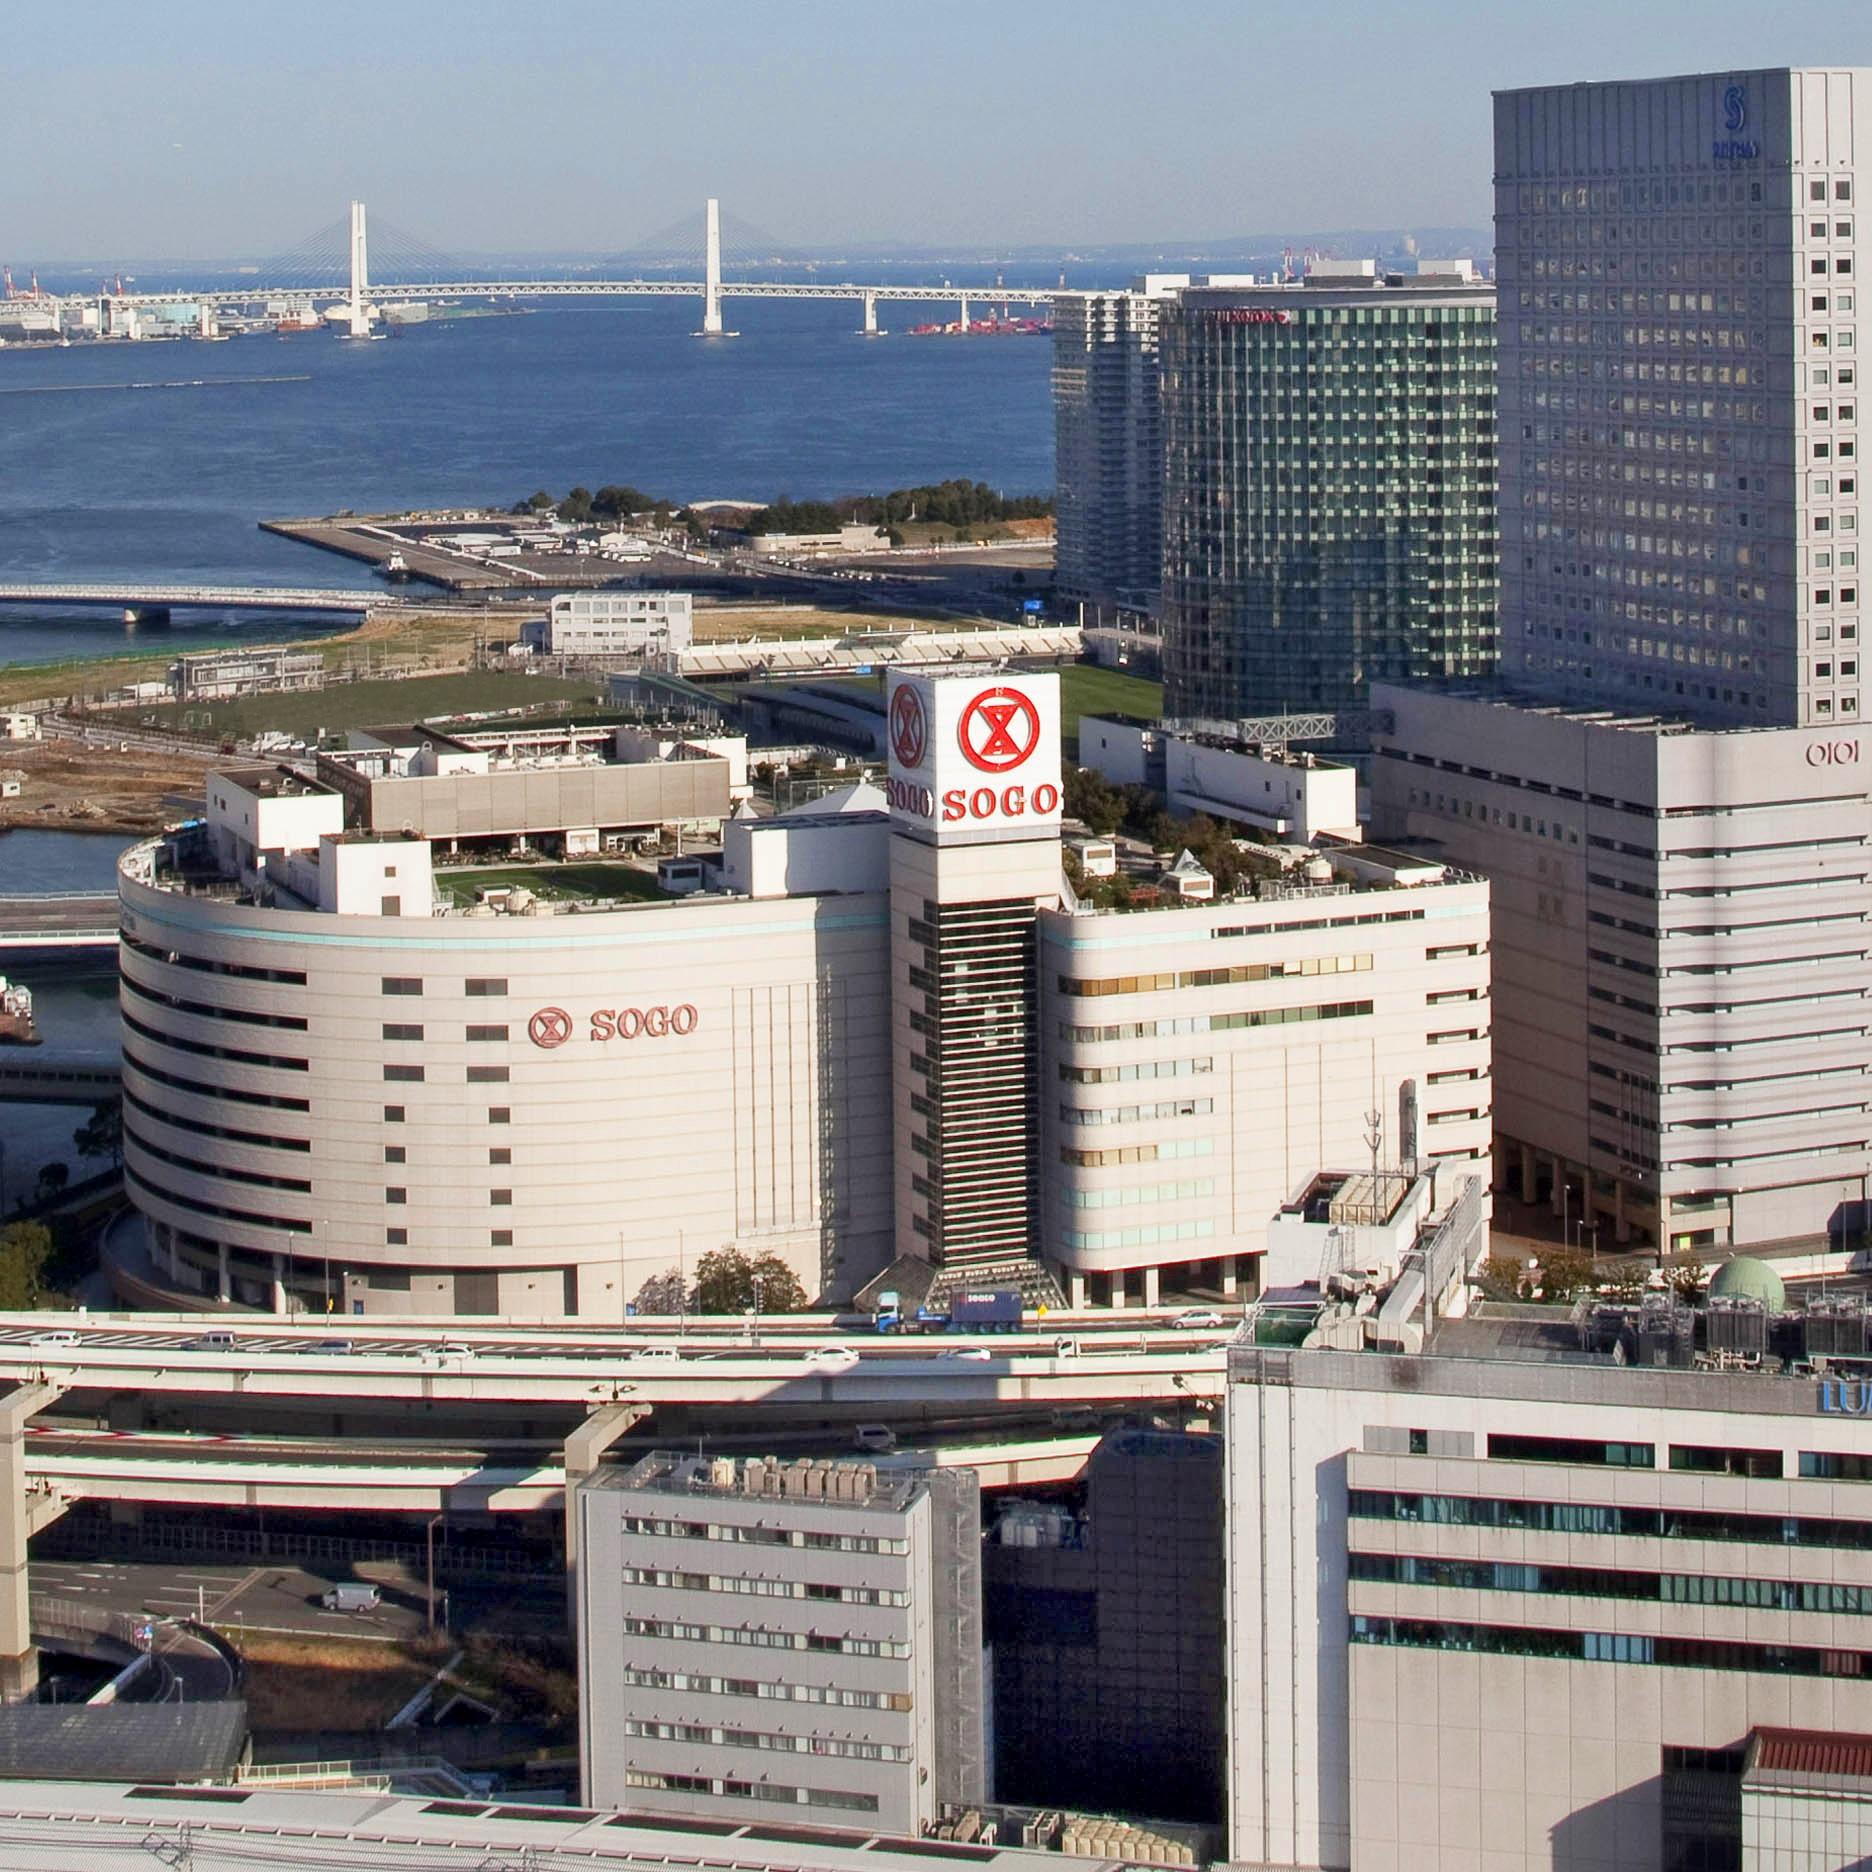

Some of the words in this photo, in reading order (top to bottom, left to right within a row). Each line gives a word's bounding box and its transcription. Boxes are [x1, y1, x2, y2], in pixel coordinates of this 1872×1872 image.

[886, 777, 934, 818] SOGO
[942, 783, 1059, 821] SOGO
[590, 1003, 698, 1041] SOGO
